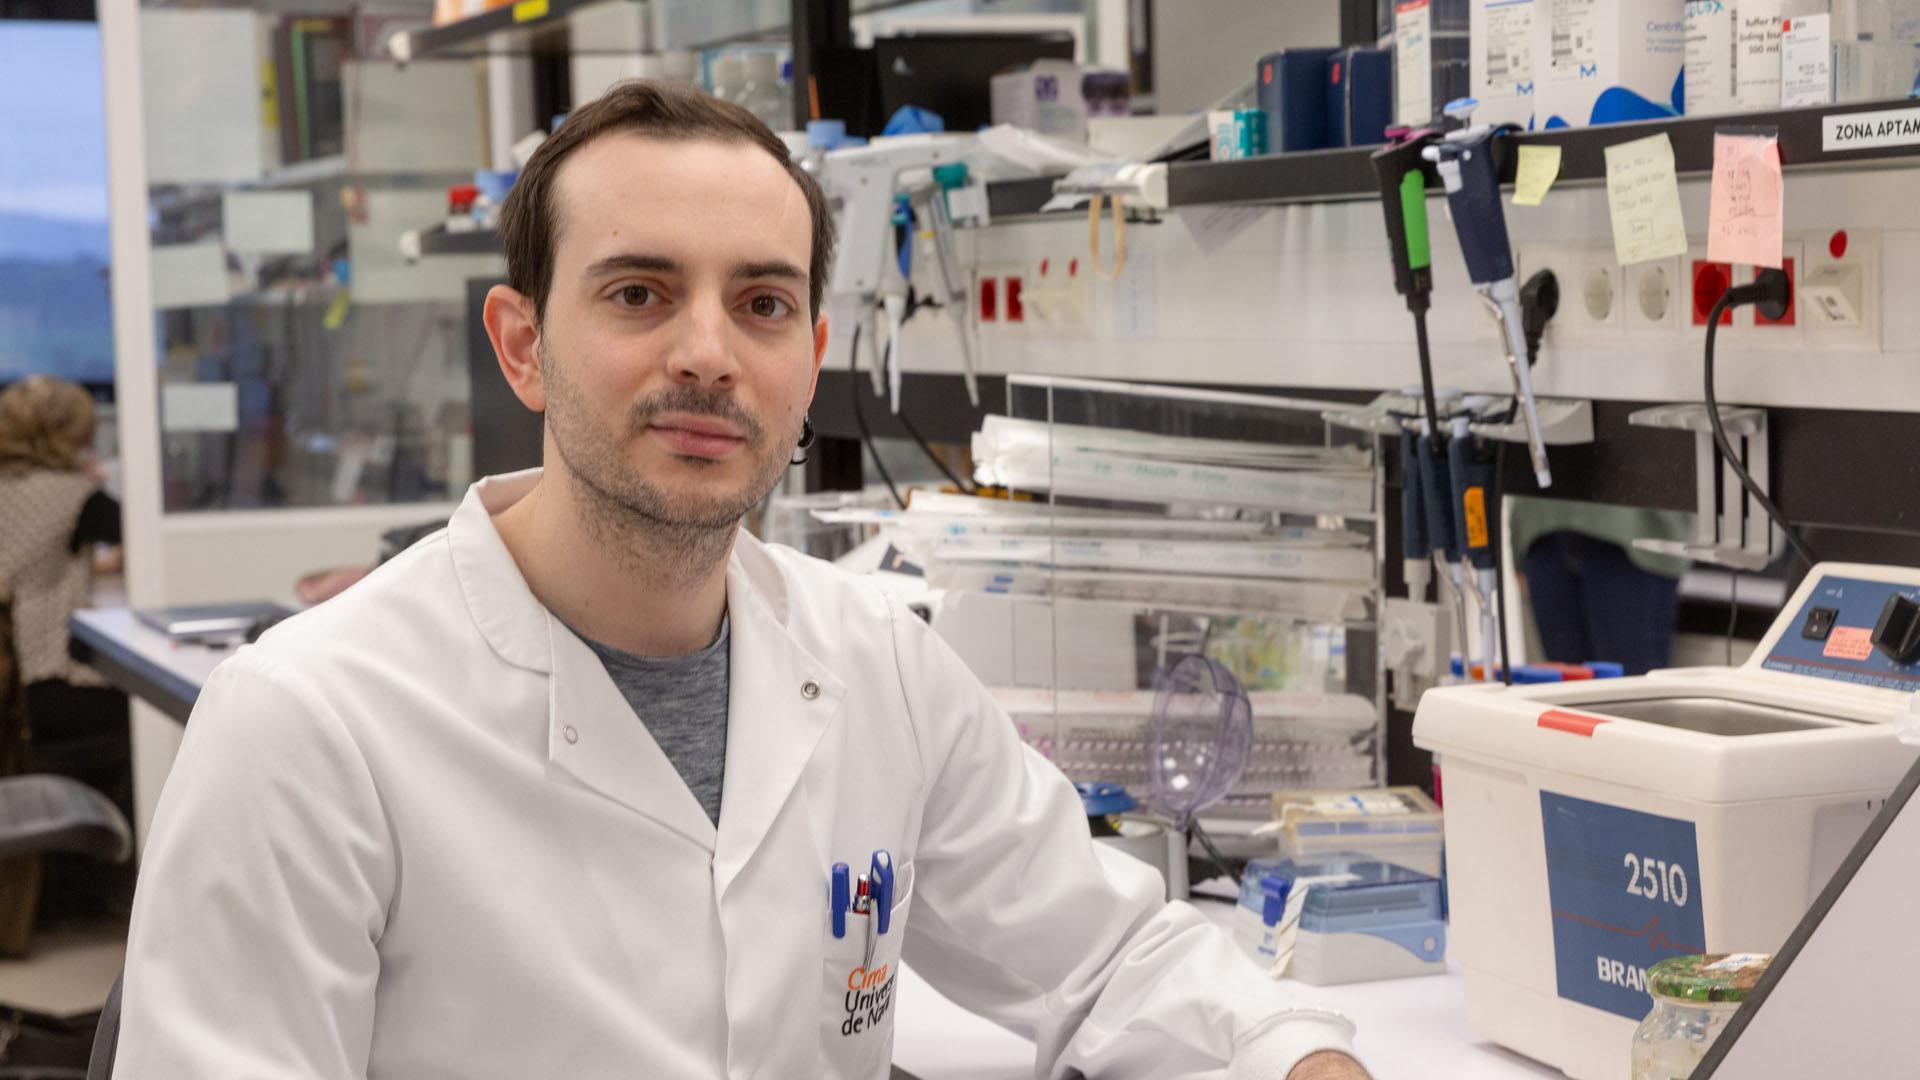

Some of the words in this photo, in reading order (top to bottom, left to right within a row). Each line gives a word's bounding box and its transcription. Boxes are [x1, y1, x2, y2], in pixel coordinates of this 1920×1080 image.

[1835, 122, 1874, 141] ZONA
[1623, 852, 1689, 908] 2510
[841, 1012, 864, 1037] de
